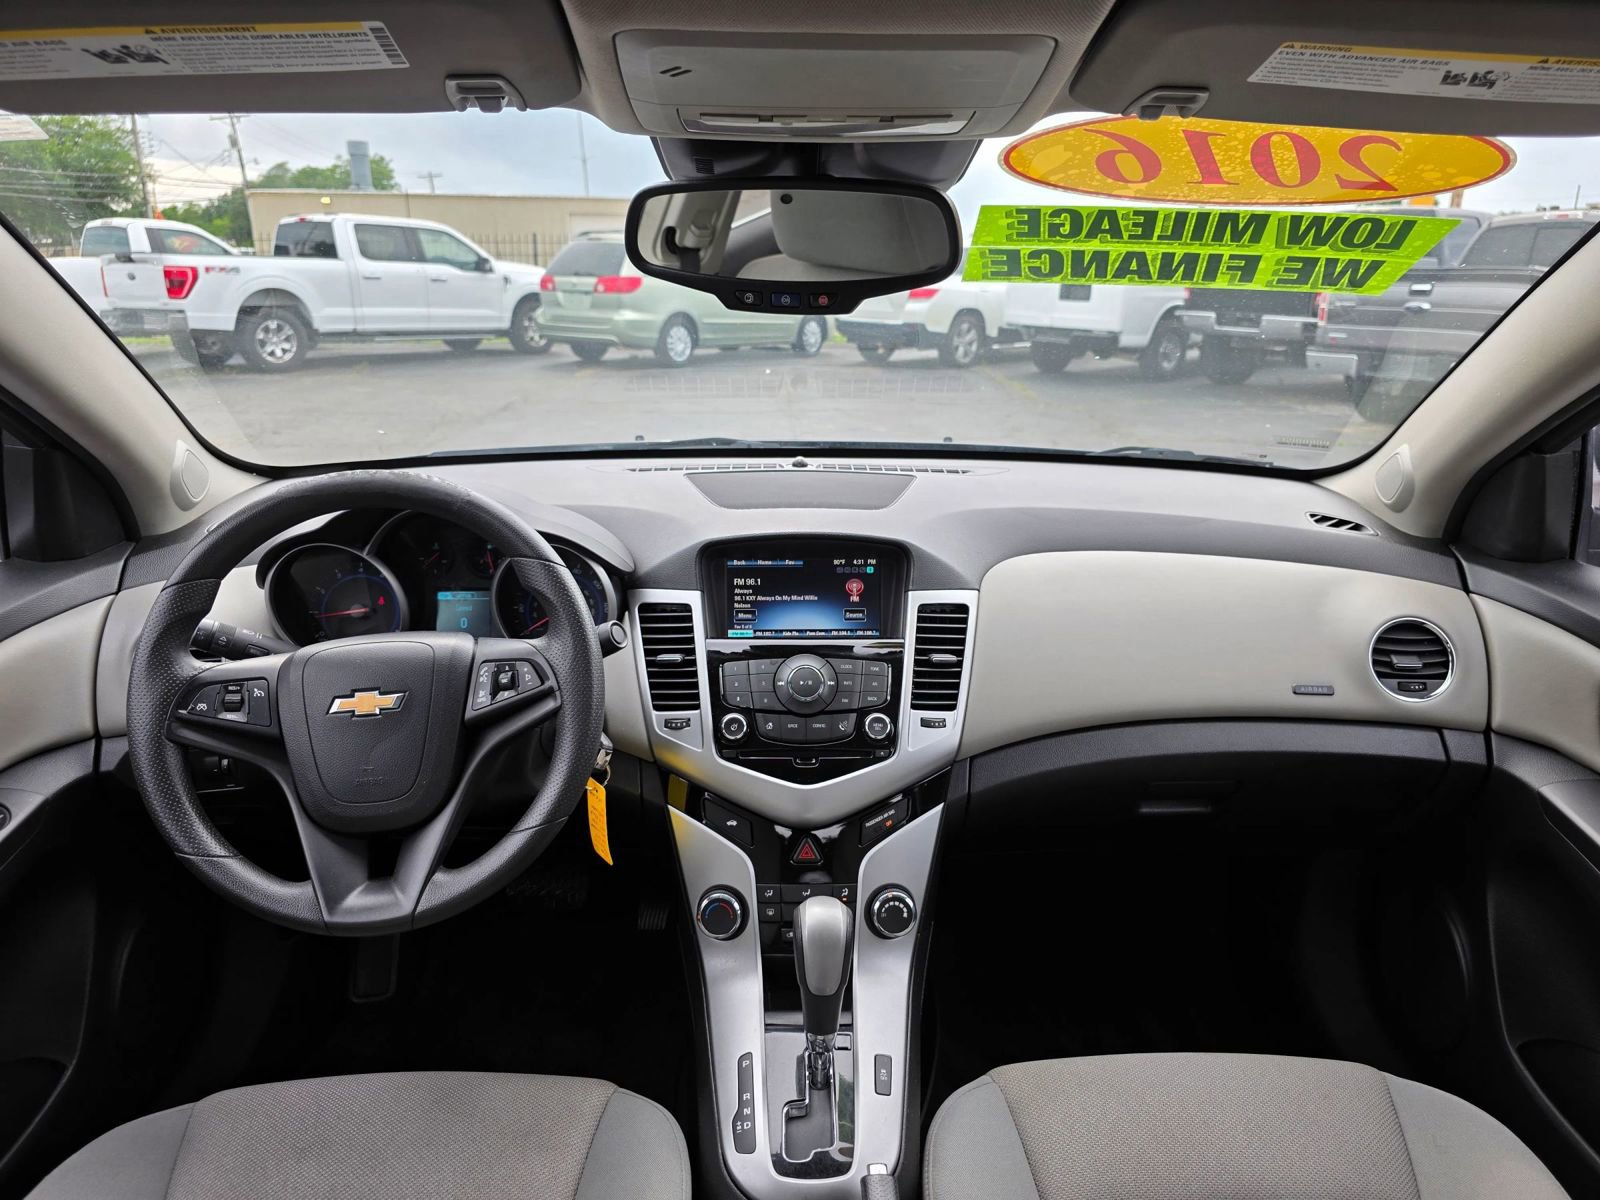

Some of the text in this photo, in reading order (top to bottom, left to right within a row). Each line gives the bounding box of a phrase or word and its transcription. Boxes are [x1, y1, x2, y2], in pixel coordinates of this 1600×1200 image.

[1299, 43, 1353, 53] WARNING
[733, 578, 745, 586] FM
[460, 617, 468, 629] 0
[742, 1060, 750, 1068] P
[743, 1107, 751, 1115] N
[743, 1121, 752, 1129] D
